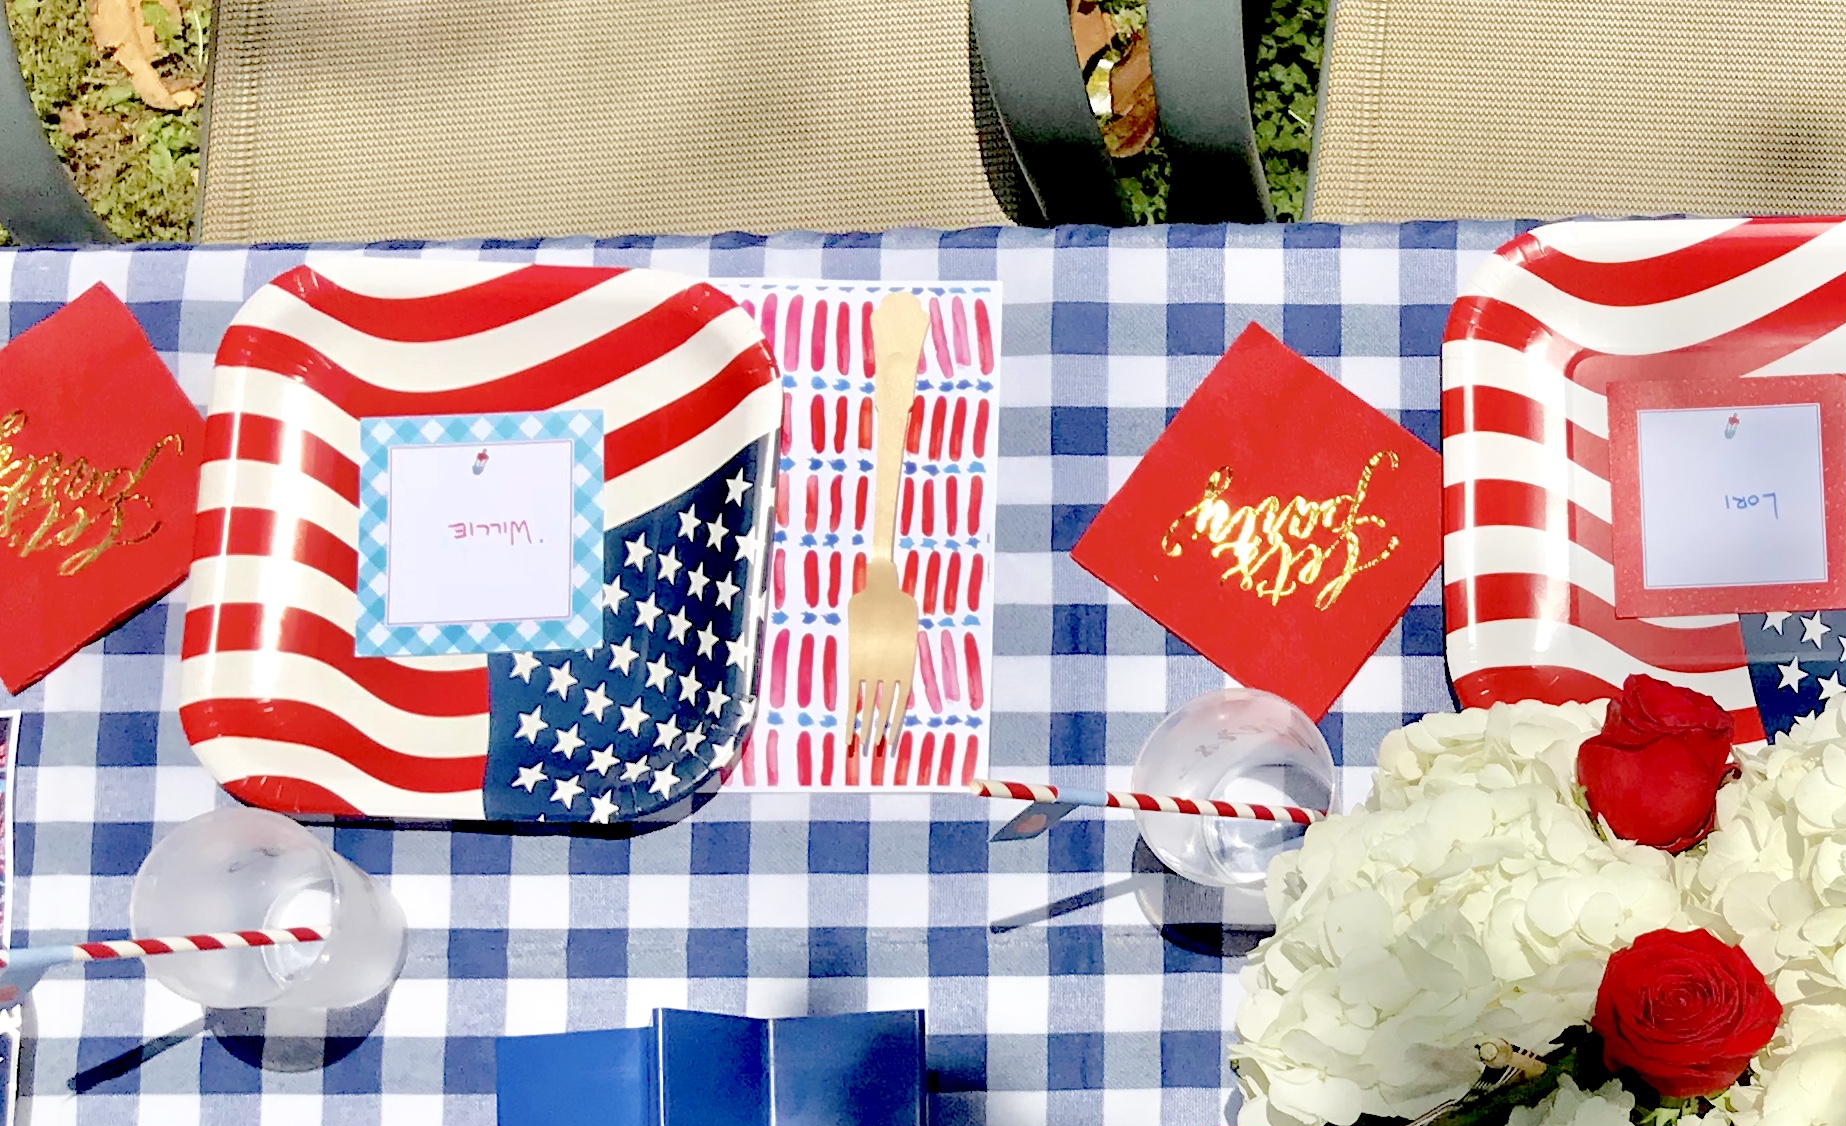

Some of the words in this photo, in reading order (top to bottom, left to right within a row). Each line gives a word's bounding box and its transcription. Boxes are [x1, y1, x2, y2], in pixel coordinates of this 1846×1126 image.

[1161, 450, 1399, 558] party
[1724, 492, 1779, 520] LORI
[447, 519, 532, 546] WILLIE
[1219, 529, 1399, 611] let's
